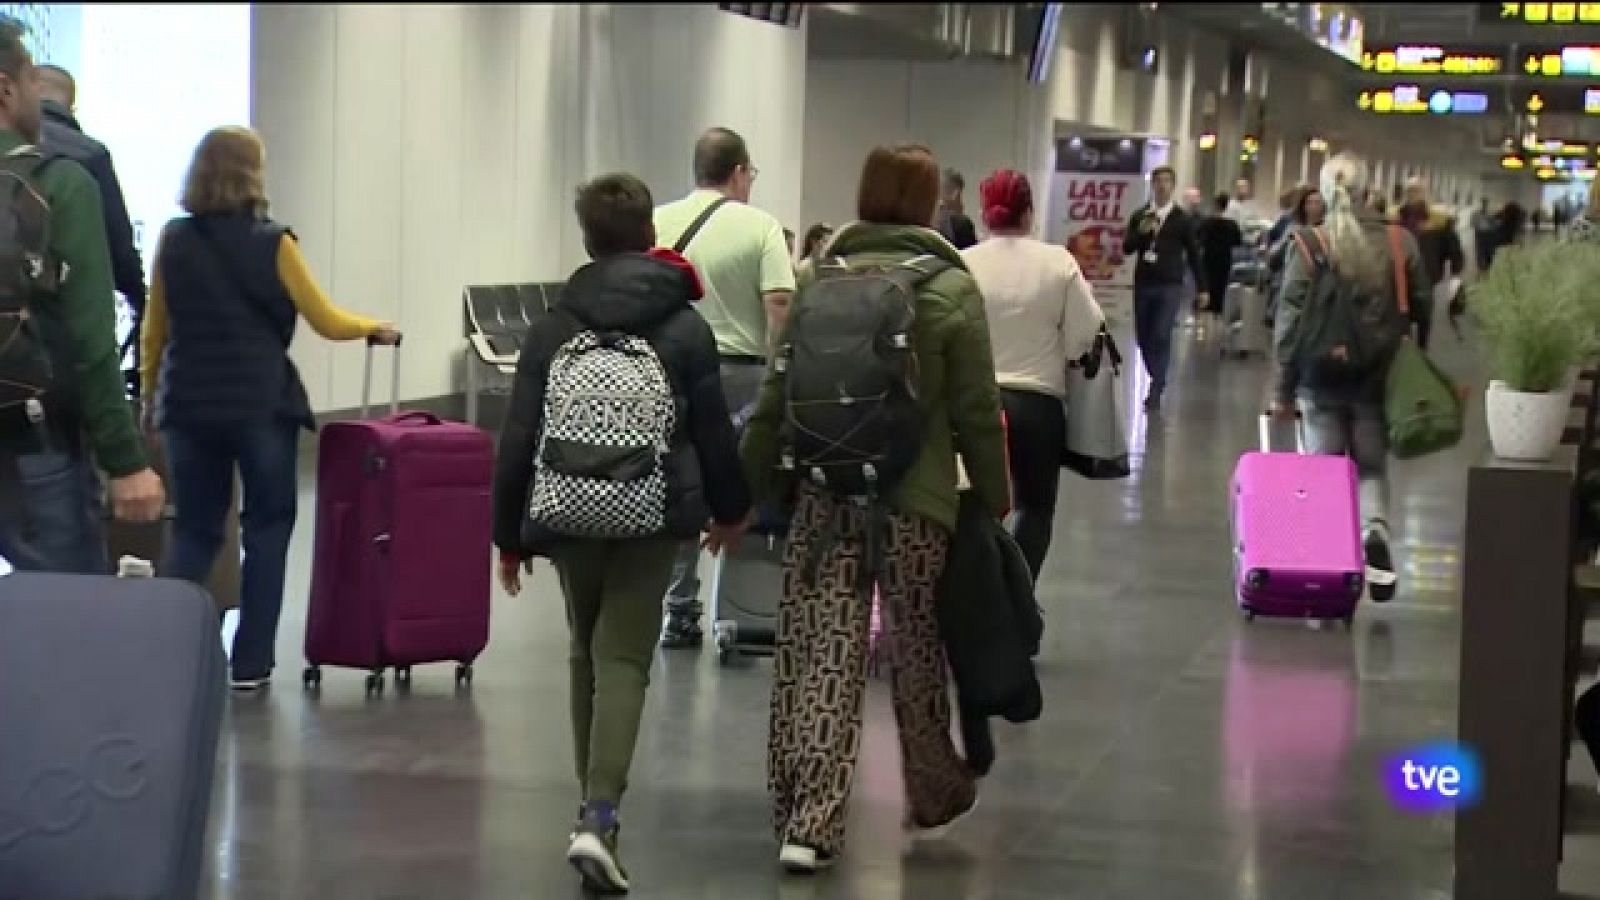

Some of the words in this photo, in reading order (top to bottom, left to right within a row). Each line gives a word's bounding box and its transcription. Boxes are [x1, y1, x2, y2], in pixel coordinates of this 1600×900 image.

[1068, 179, 1128, 201] LAST
[1068, 201, 1124, 221] CALL
[553, 391, 656, 432] VANS
